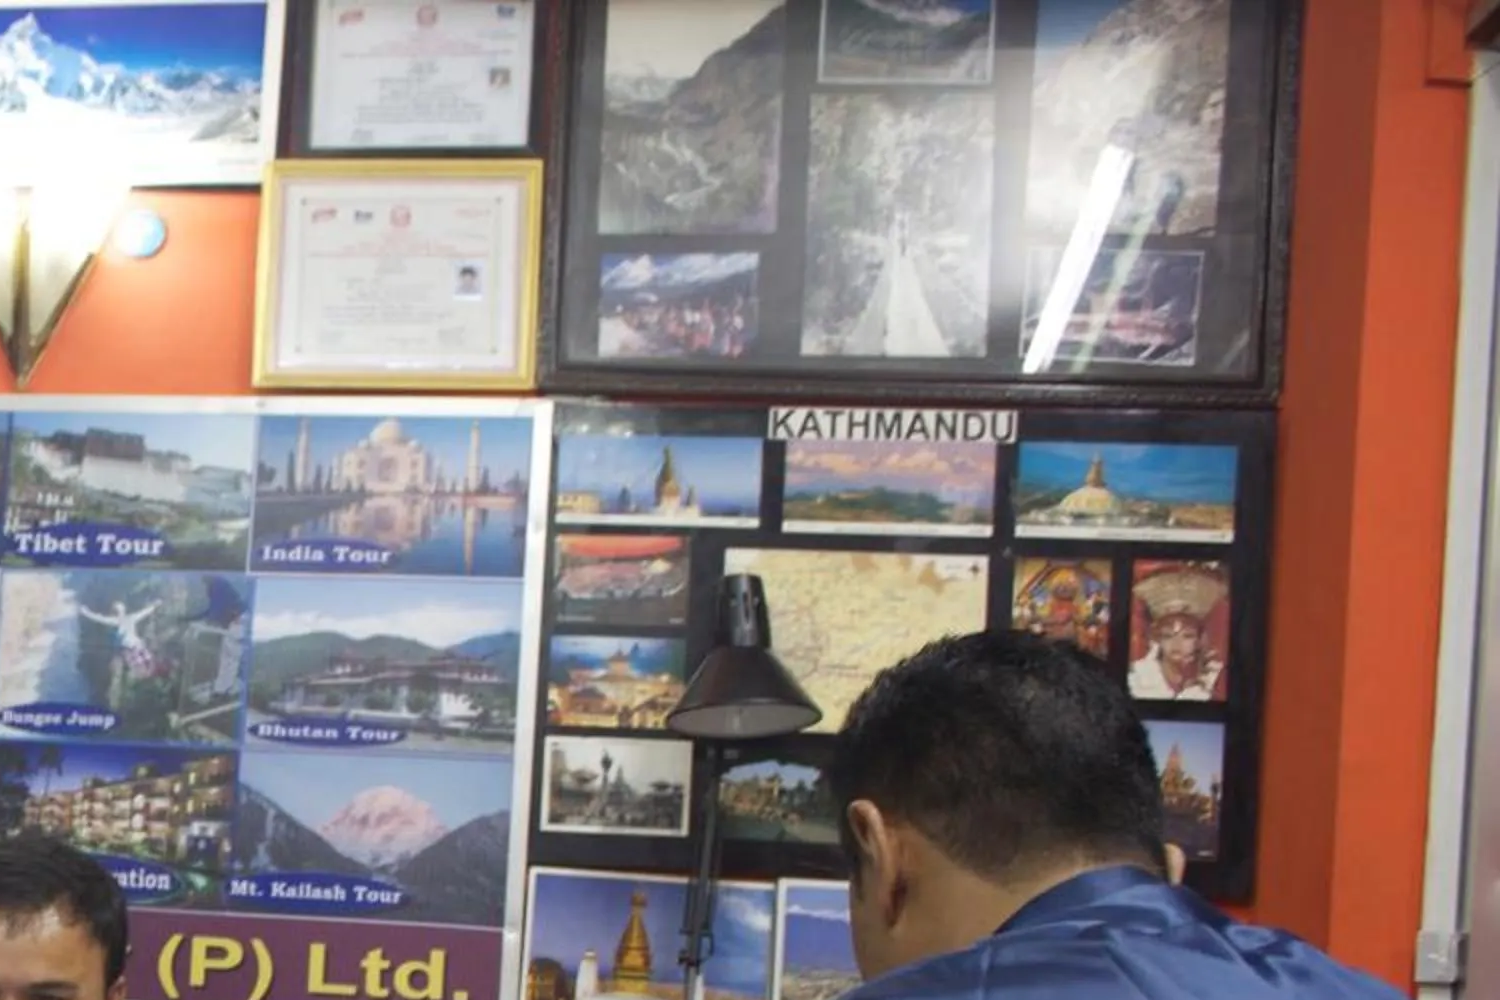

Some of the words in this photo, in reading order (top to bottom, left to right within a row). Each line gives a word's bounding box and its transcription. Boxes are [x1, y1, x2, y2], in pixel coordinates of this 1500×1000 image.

[771, 410, 1015, 442] KATHMANDU
[15, 531, 87, 554] Tibet
[96, 532, 164, 556] Tour
[261, 543, 325, 562] India
[332, 545, 393, 565] Tour
[66, 709, 116, 731] Jump
[256, 723, 339, 740] Bhutan
[345, 726, 400, 742] Tour
[111, 866, 171, 892] ation
[229, 879, 264, 898] Mt.
[270, 881, 347, 902] Kailash
[353, 884, 403, 905] Tour
